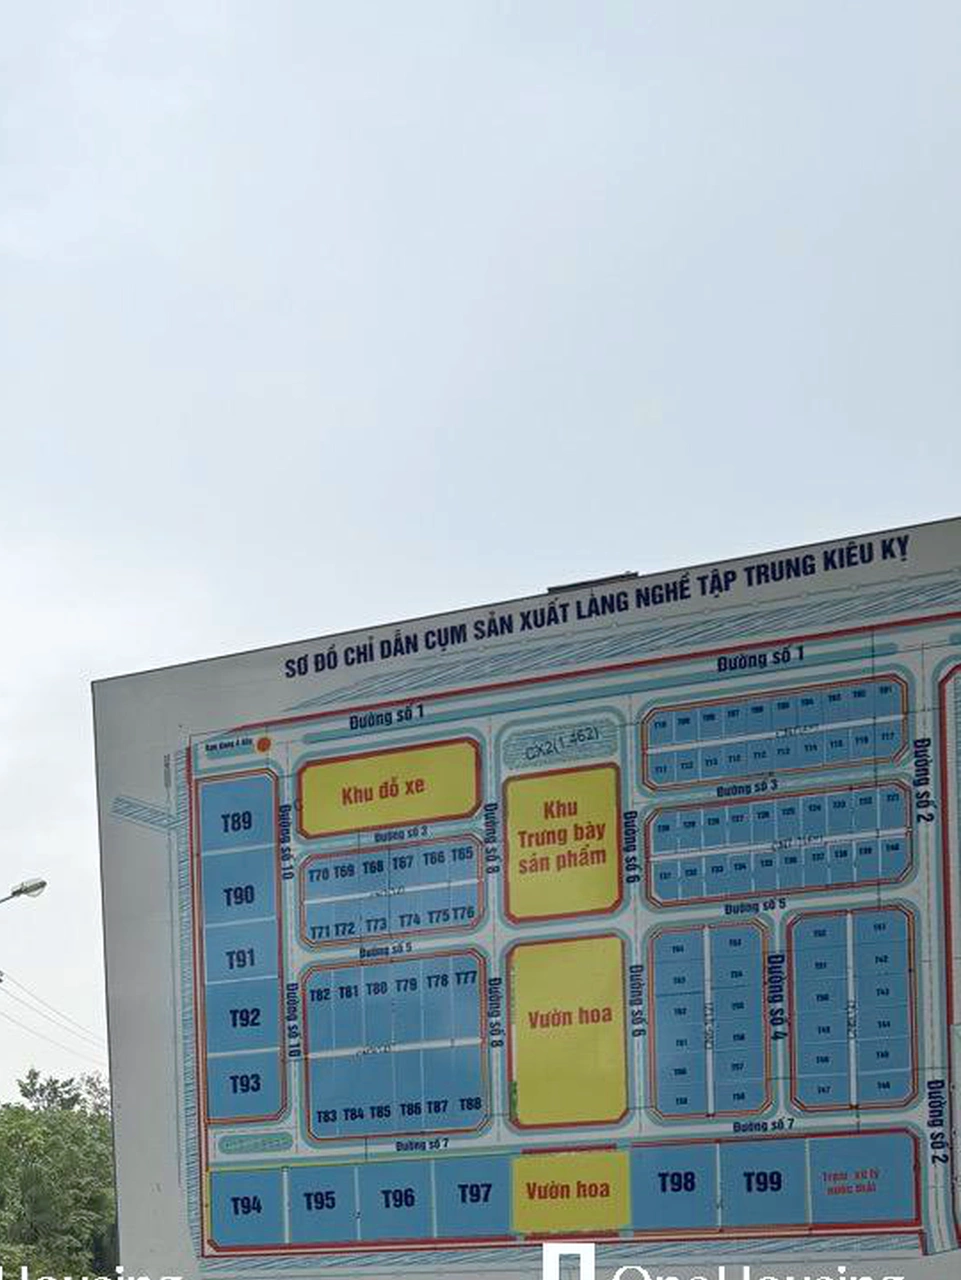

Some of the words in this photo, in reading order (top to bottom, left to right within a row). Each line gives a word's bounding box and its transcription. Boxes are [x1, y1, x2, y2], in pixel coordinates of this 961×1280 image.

[285, 654, 308, 678] SƠ
[344, 636, 374, 667] CHỈ
[380, 629, 419, 660] DẪN
[424, 624, 467, 651] CỤM
[474, 611, 513, 639] SẢN
[520, 600, 569, 631] XUẤT
[697, 568, 737, 598] TẬP
[744, 556, 816, 587] TRUNG
[881, 535, 910, 562] KỴ
[717, 651, 767, 672] Đường
[771, 645, 791, 667] số
[798, 646, 805, 660] 1
[349, 710, 392, 730] Đường
[396, 704, 413, 721] số
[417, 704, 424, 718] 1
[913, 738, 932, 787] Đường
[342, 785, 373, 806] Khu
[405, 778, 425, 796] xe
[915, 791, 938, 808] số
[544, 801, 577, 820] Khu
[916, 813, 934, 822] 2
[221, 811, 252, 833] T89
[518, 827, 568, 848] Trưng
[574, 821, 606, 842] bày
[452, 846, 473, 861] T65
[518, 853, 550, 874] sản
[556, 844, 607, 871] phẩm
[392, 856, 414, 870] T67
[486, 865, 500, 874] 8
[282, 865, 295, 880] 10
[626, 875, 641, 884] 6
[223, 885, 255, 908] T90
[427, 910, 450, 924] T75
[452, 906, 475, 920] T76
[366, 918, 387, 932] T73
[399, 914, 421, 928] T74
[310, 925, 330, 939] T71
[334, 922, 356, 936] T72
[225, 949, 256, 971] T91
[395, 978, 417, 992] T79
[426, 974, 448, 989] T78
[455, 971, 478, 986] T77
[767, 955, 787, 1004] Đường
[309, 988, 331, 1001] T82
[339, 985, 359, 998] T81
[229, 1007, 261, 1028] T92
[528, 1009, 573, 1029] Vườn
[579, 1006, 613, 1025] hoa
[769, 1008, 788, 1026] số
[632, 1029, 646, 1037] 6
[771, 1031, 788, 1041] 4
[288, 1043, 301, 1057] 10
[229, 1073, 261, 1094] T93
[400, 1102, 422, 1116] T86
[427, 1100, 448, 1114] T87
[459, 1097, 482, 1111] T88
[927, 1079, 947, 1127] Đường
[317, 1110, 337, 1123] T83
[343, 1107, 364, 1121] T84
[369, 1105, 391, 1119] T85
[930, 1132, 949, 1149] số
[931, 1154, 949, 1164] 2
[658, 1172, 696, 1192] T98
[743, 1171, 782, 1192] T99
[458, 1183, 492, 1203] T97
[526, 1180, 570, 1200] Vườn
[575, 1180, 610, 1199] hoa
[231, 1196, 262, 1216] T94
[303, 1191, 336, 1211] T95
[382, 1188, 415, 1210] T96
